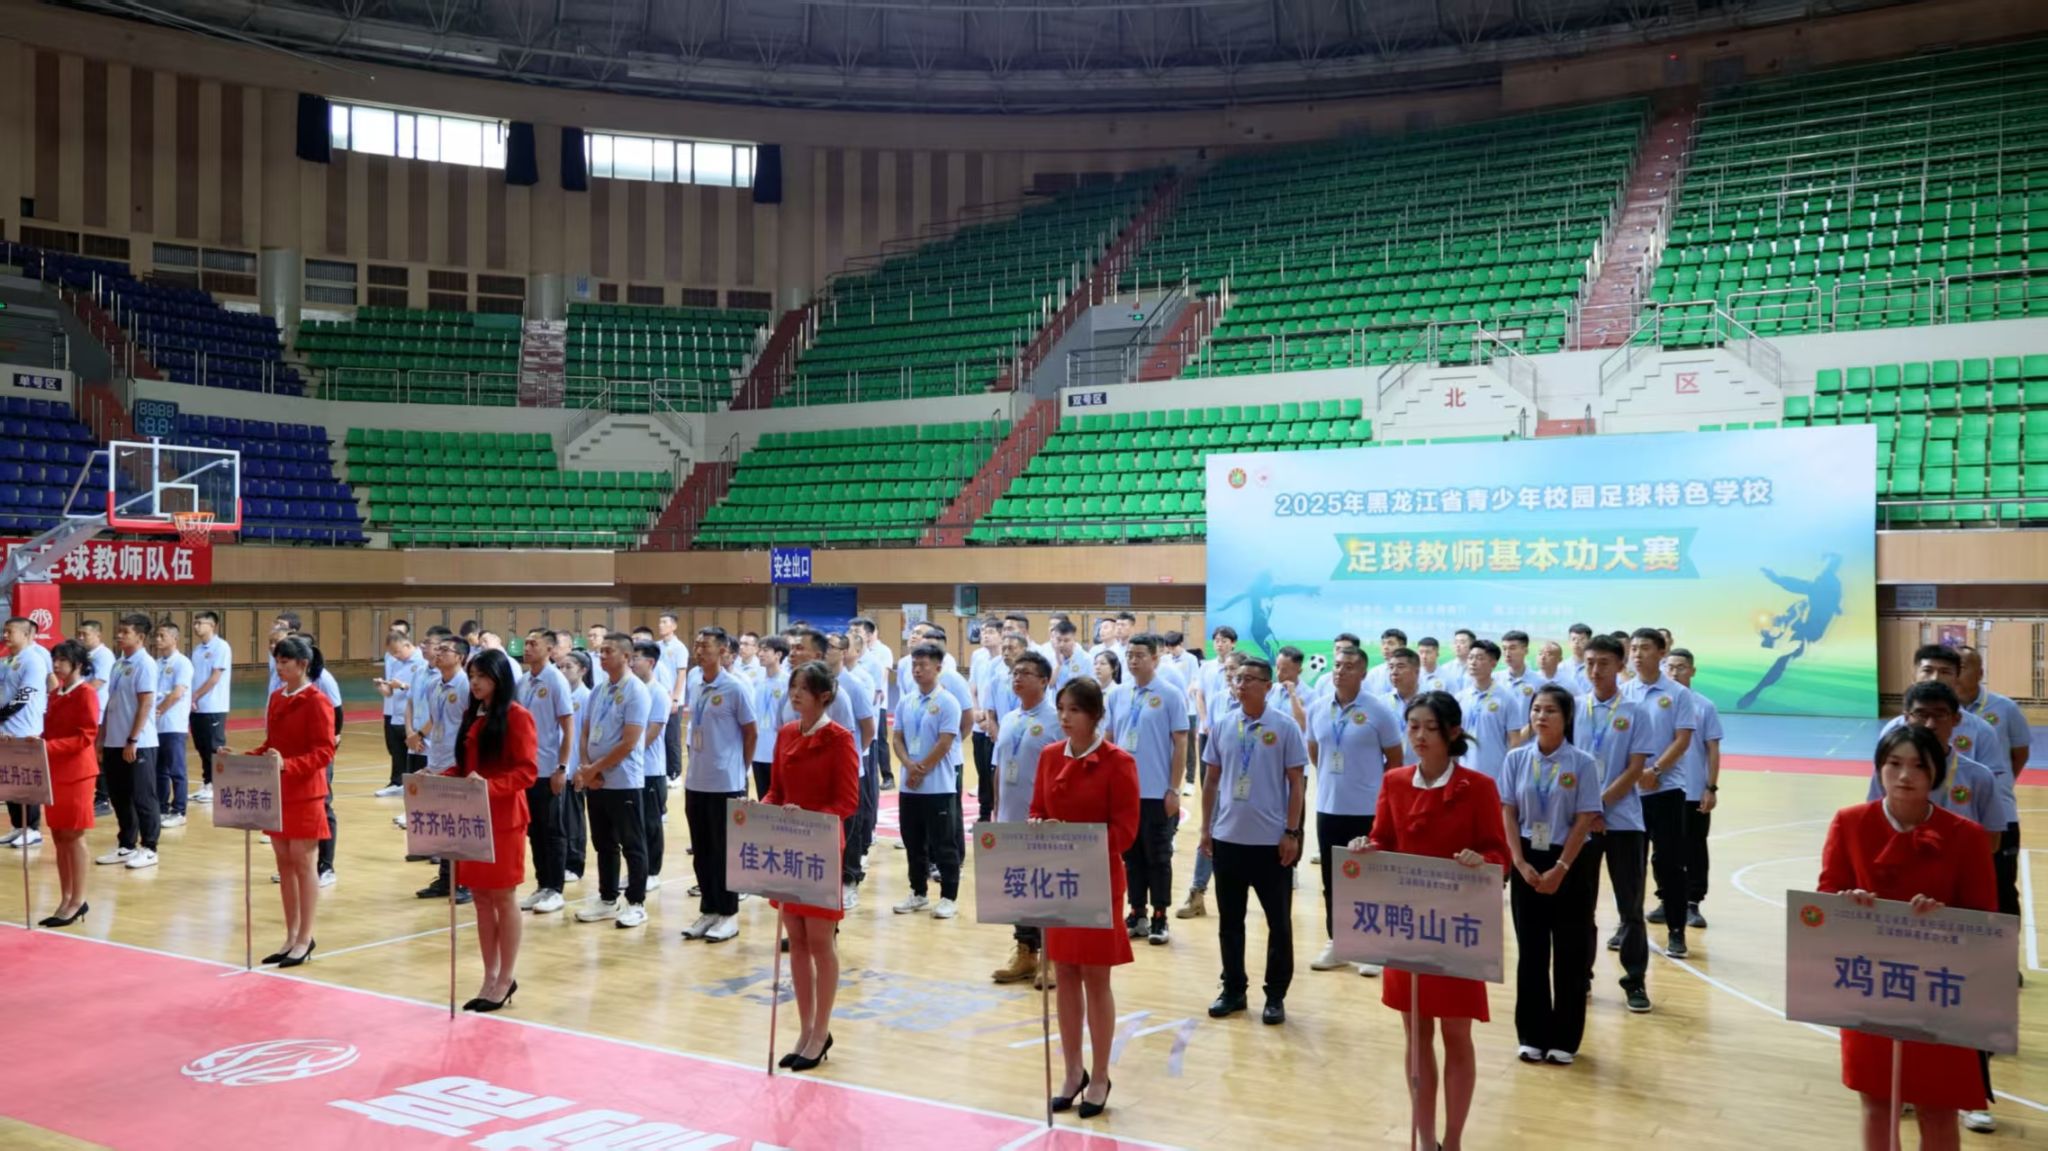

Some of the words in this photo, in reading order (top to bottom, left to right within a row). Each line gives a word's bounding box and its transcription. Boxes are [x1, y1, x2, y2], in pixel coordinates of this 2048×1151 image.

[18, 376, 57, 390] 单号区
[1445, 388, 1466, 408] 北
[1675, 372, 1699, 393] 区
[1276, 479, 1772, 516] 2025年黑龙江省青少年校园足球特色学校
[774, 553, 809, 578] 安全出口
[1347, 536, 1680, 573] 足球教师基本功大赛
[220, 787, 272, 811] 哈尔滨市
[411, 810, 486, 840] 齐齐哈尔市
[739, 842, 826, 882] 佳木斯市
[1004, 867, 1080, 899] 绥化市
[1352, 901, 1482, 948] 双鸭山市
[1834, 955, 1966, 1008] 鸡西市
